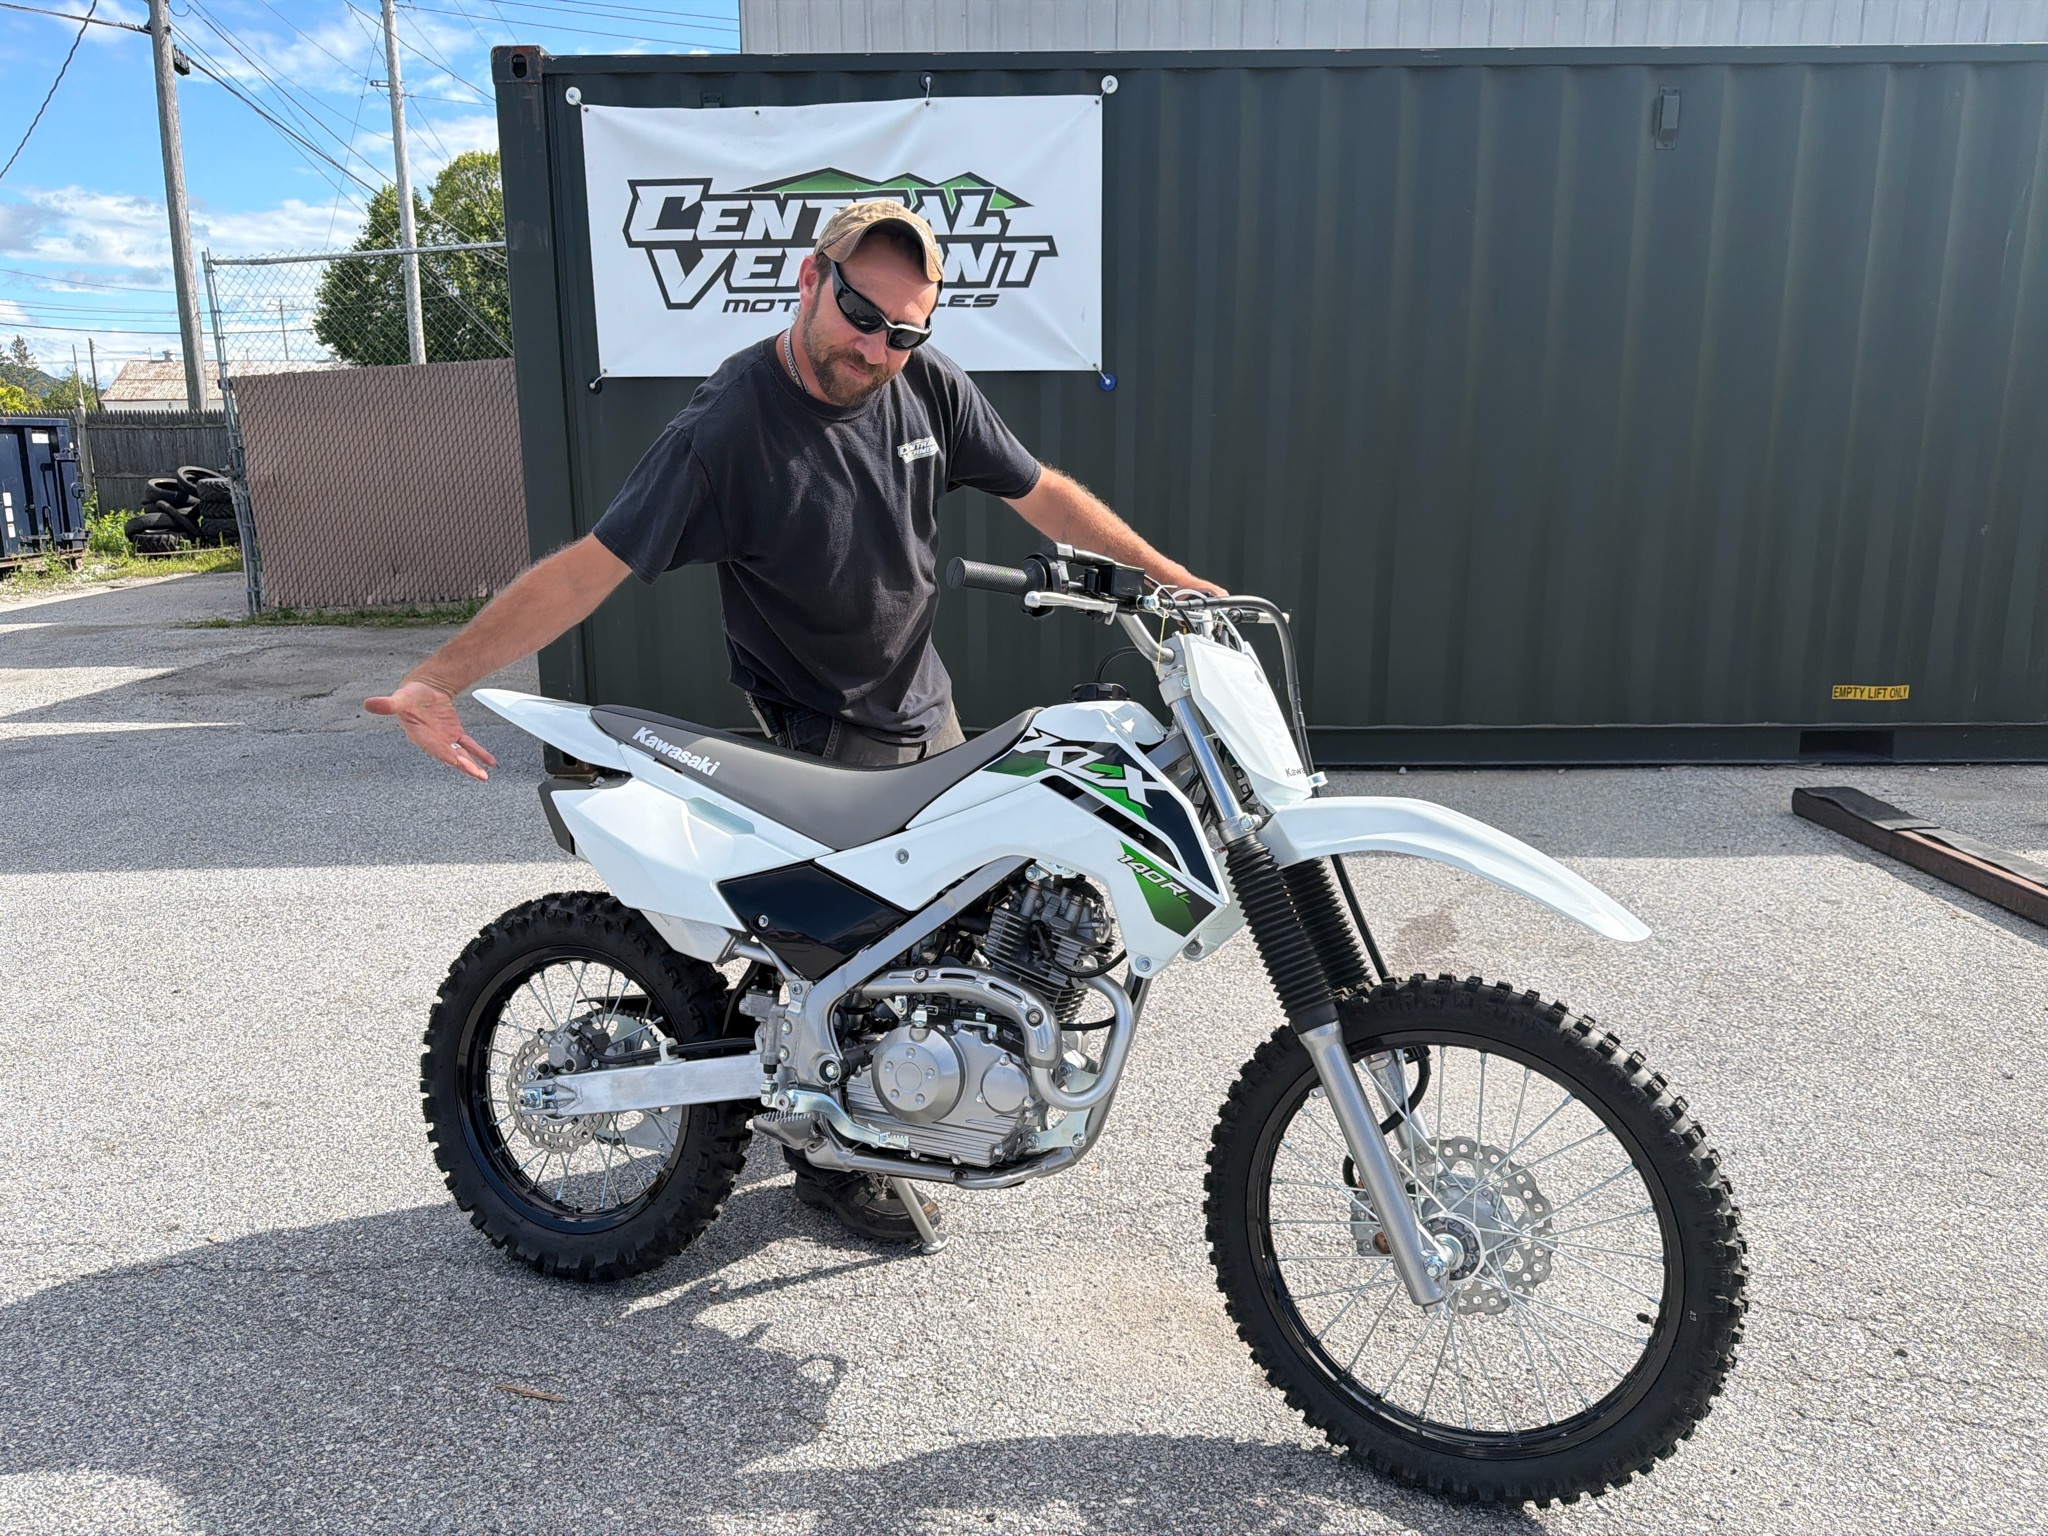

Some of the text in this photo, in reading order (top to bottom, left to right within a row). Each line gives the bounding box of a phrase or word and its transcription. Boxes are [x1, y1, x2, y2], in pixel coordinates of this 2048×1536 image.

[626, 180, 1003, 243] CENTAL
[649, 239, 1053, 306] VENT
[1834, 687, 1907, 698] EMPTY LIFT ONLY
[632, 726, 720, 776] Kawasaki
[1015, 727, 1168, 808] KLX
